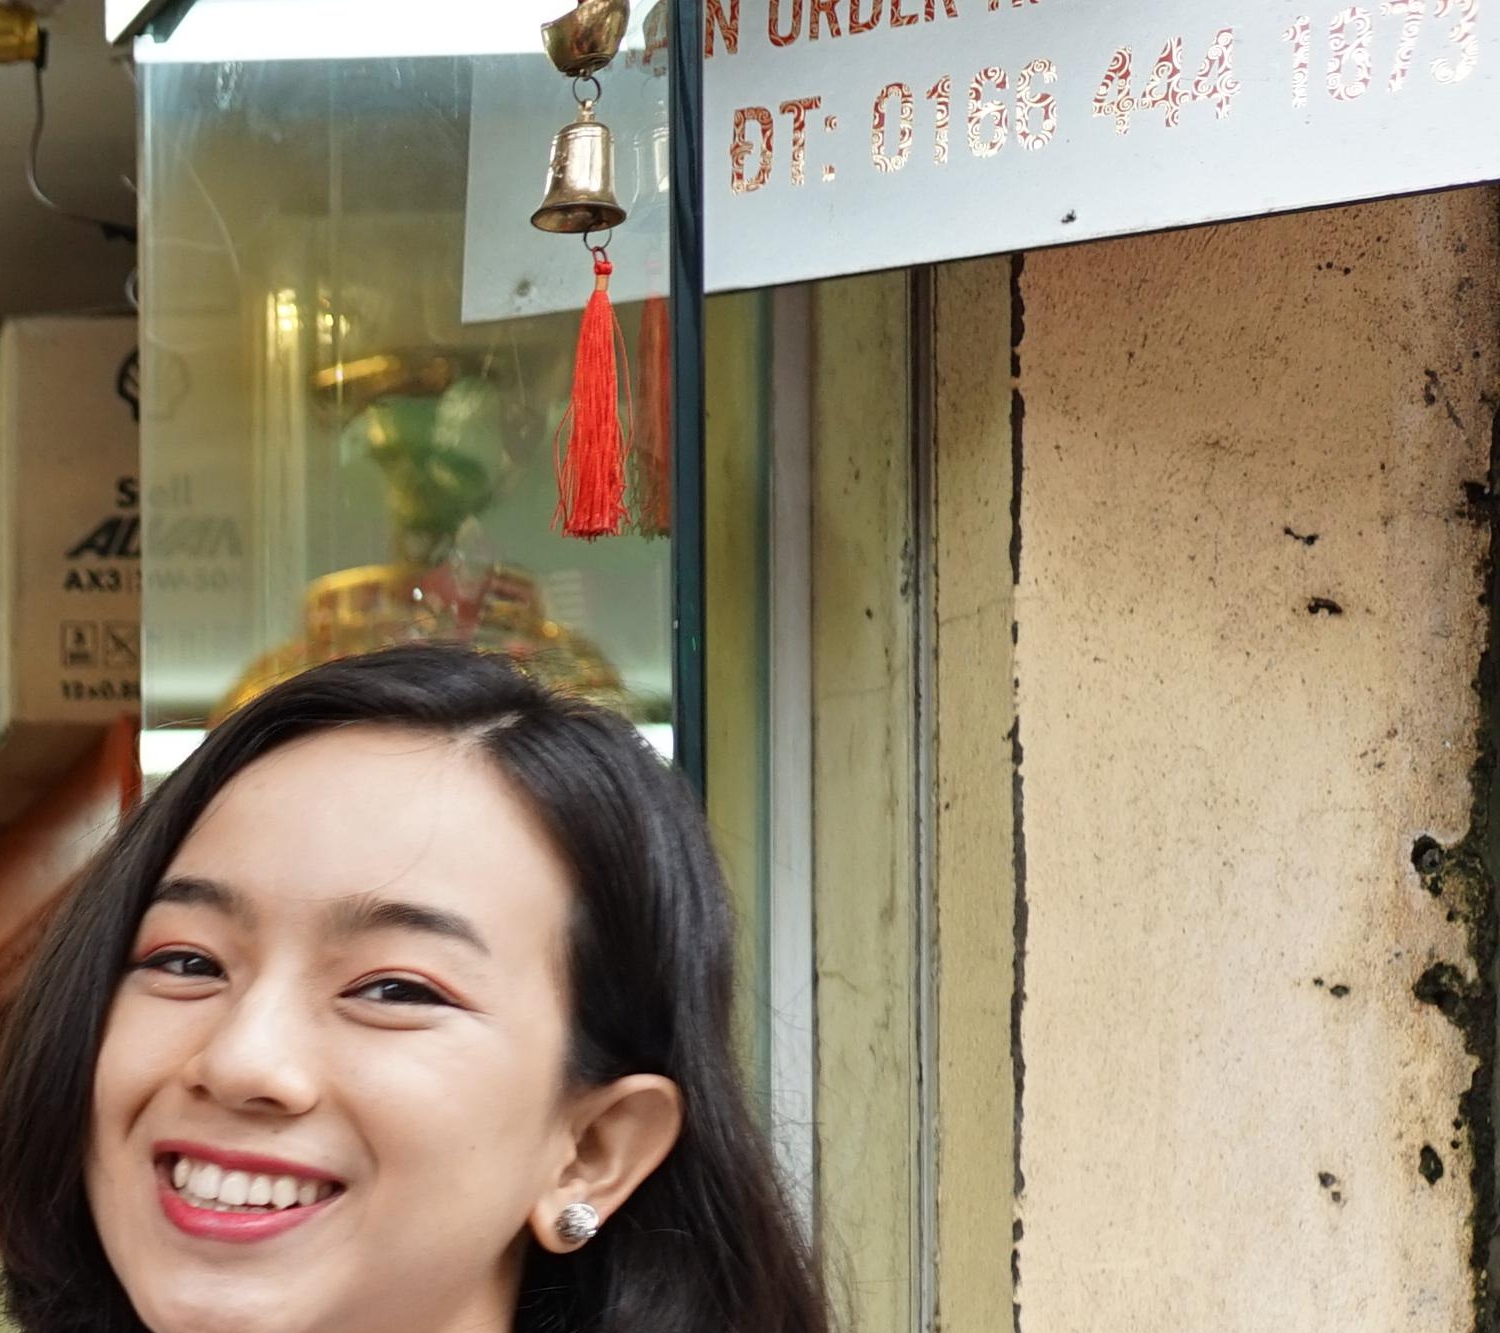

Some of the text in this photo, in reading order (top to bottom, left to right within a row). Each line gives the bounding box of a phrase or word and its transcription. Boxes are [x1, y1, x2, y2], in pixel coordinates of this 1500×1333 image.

[730, 96, 838, 196] ĐT:
[870, 57, 1058, 173] 0166
[1092, 25, 1241, 134] 444
